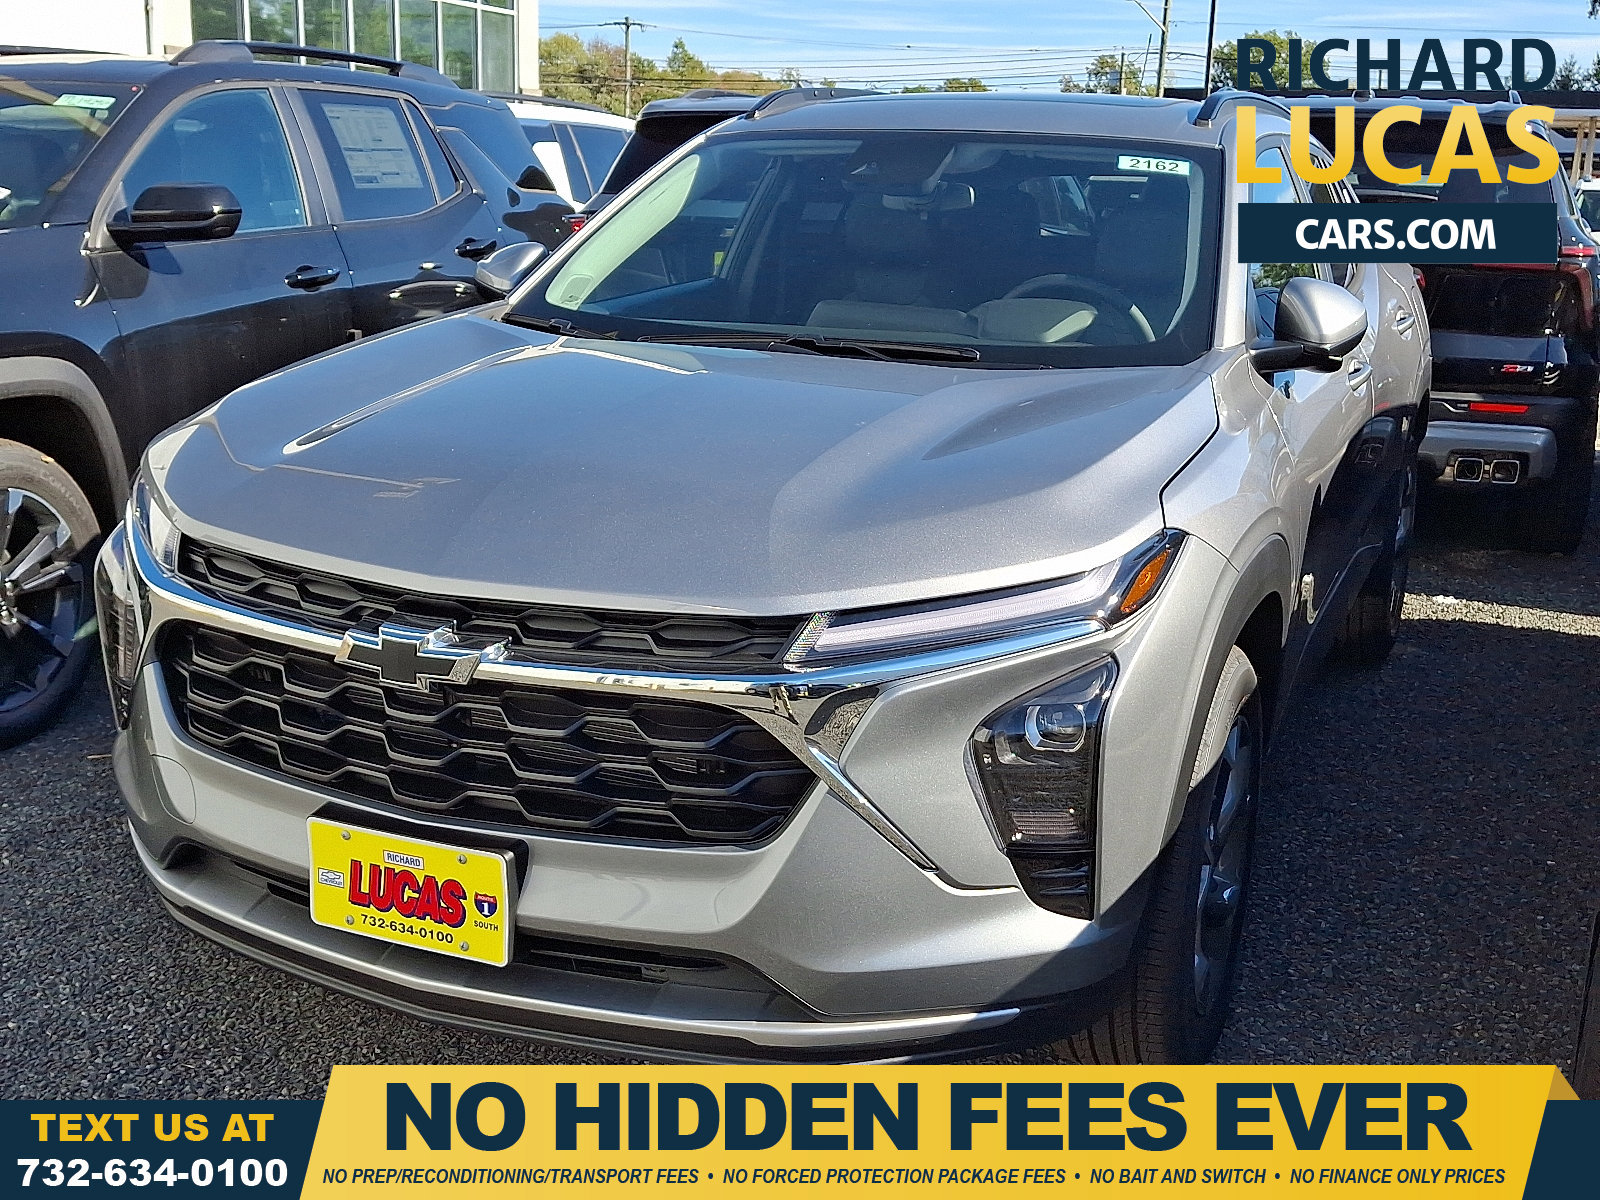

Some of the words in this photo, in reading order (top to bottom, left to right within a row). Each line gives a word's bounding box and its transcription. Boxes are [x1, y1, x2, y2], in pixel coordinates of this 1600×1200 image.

[1129, 158, 1179, 173] 2162
[386, 852, 421, 867] RICHARD
[349, 859, 468, 928] LUCAS
[481, 902, 491, 916] 1
[361, 914, 454, 944] 732-634-0100
[474, 920, 499, 932] SOUTH
